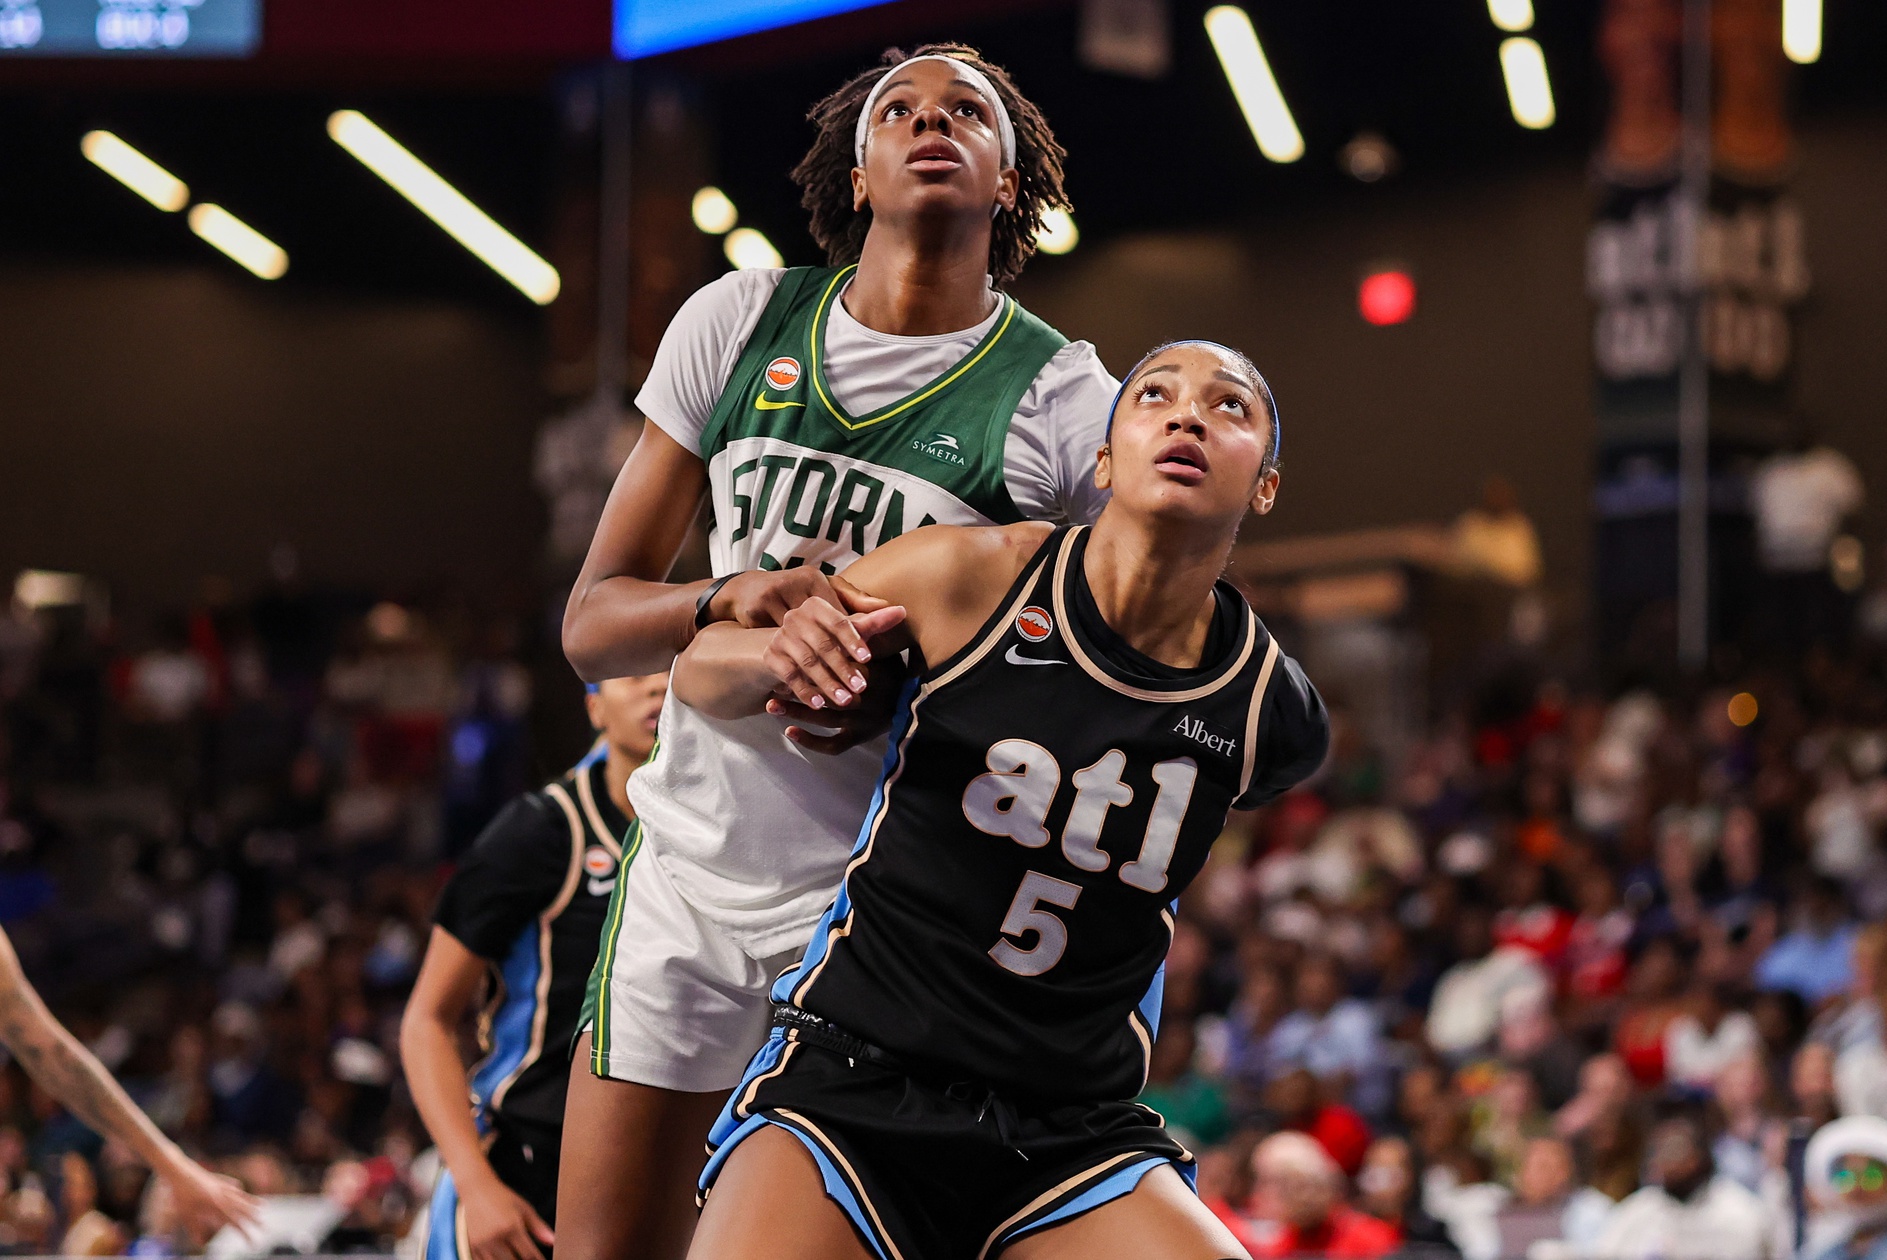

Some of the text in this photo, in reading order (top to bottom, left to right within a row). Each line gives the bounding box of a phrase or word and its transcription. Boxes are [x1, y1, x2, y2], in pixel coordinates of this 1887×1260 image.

[912, 440, 965, 466] SYMETRA
[1173, 714, 1237, 758] Albert
[961, 738, 1198, 894] atl
[987, 869, 1084, 977] 5
